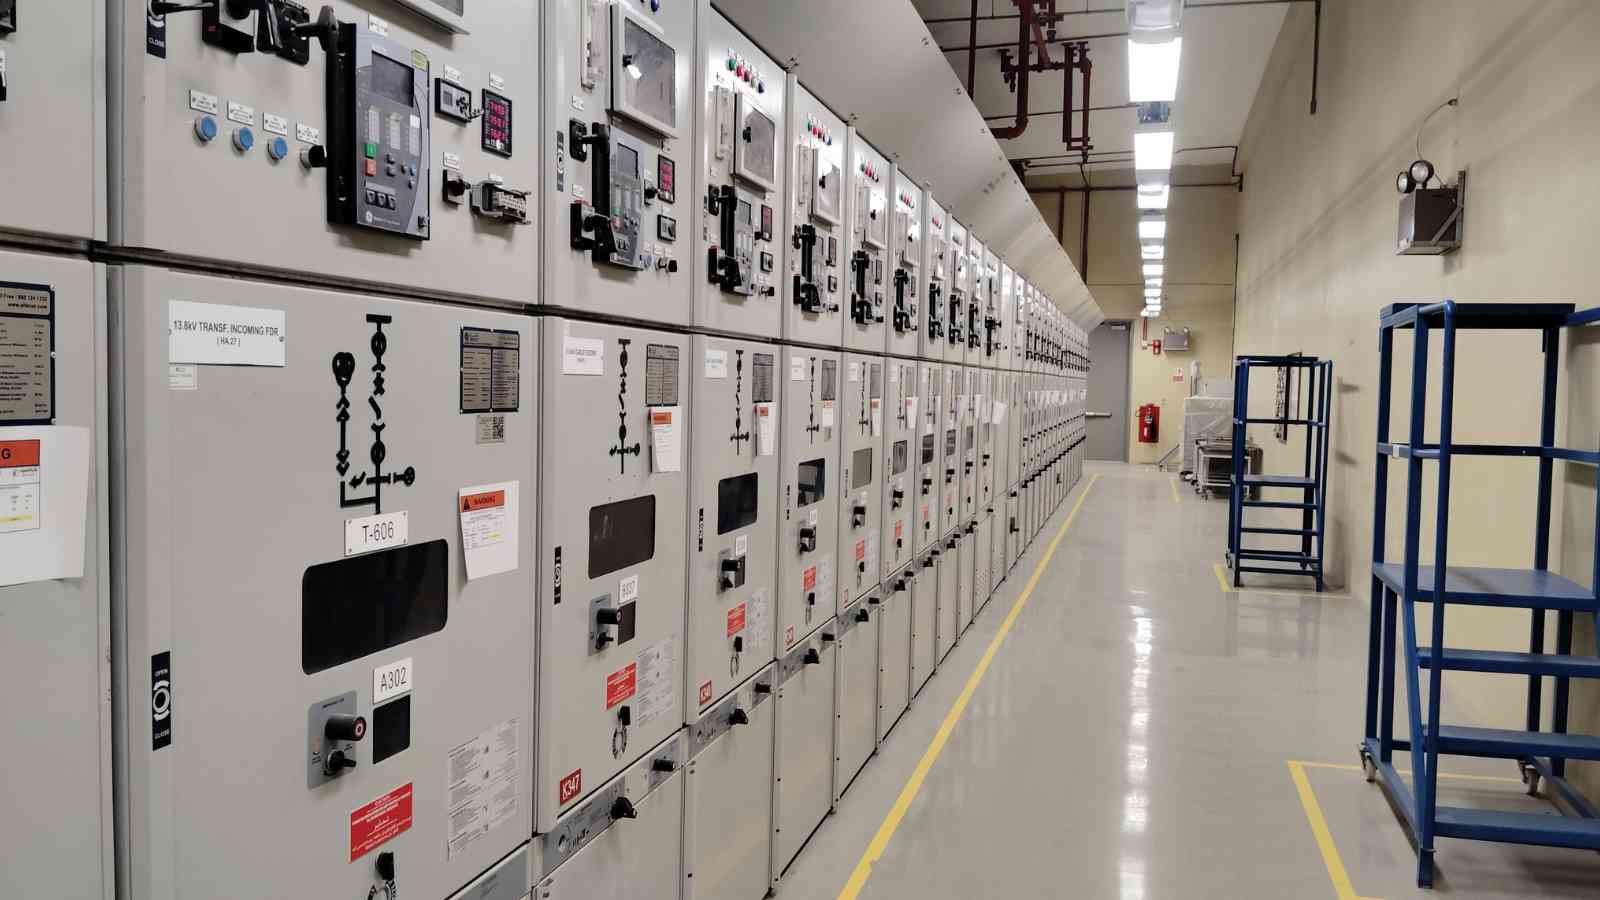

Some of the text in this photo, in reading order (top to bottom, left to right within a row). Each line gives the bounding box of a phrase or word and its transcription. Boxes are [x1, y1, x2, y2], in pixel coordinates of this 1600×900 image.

[174, 320, 197, 332] 13.8kV
[231, 323, 264, 336] INCOMING
[362, 521, 394, 544] T-606
[381, 666, 407, 692] A302
[562, 774, 580, 801] K347
